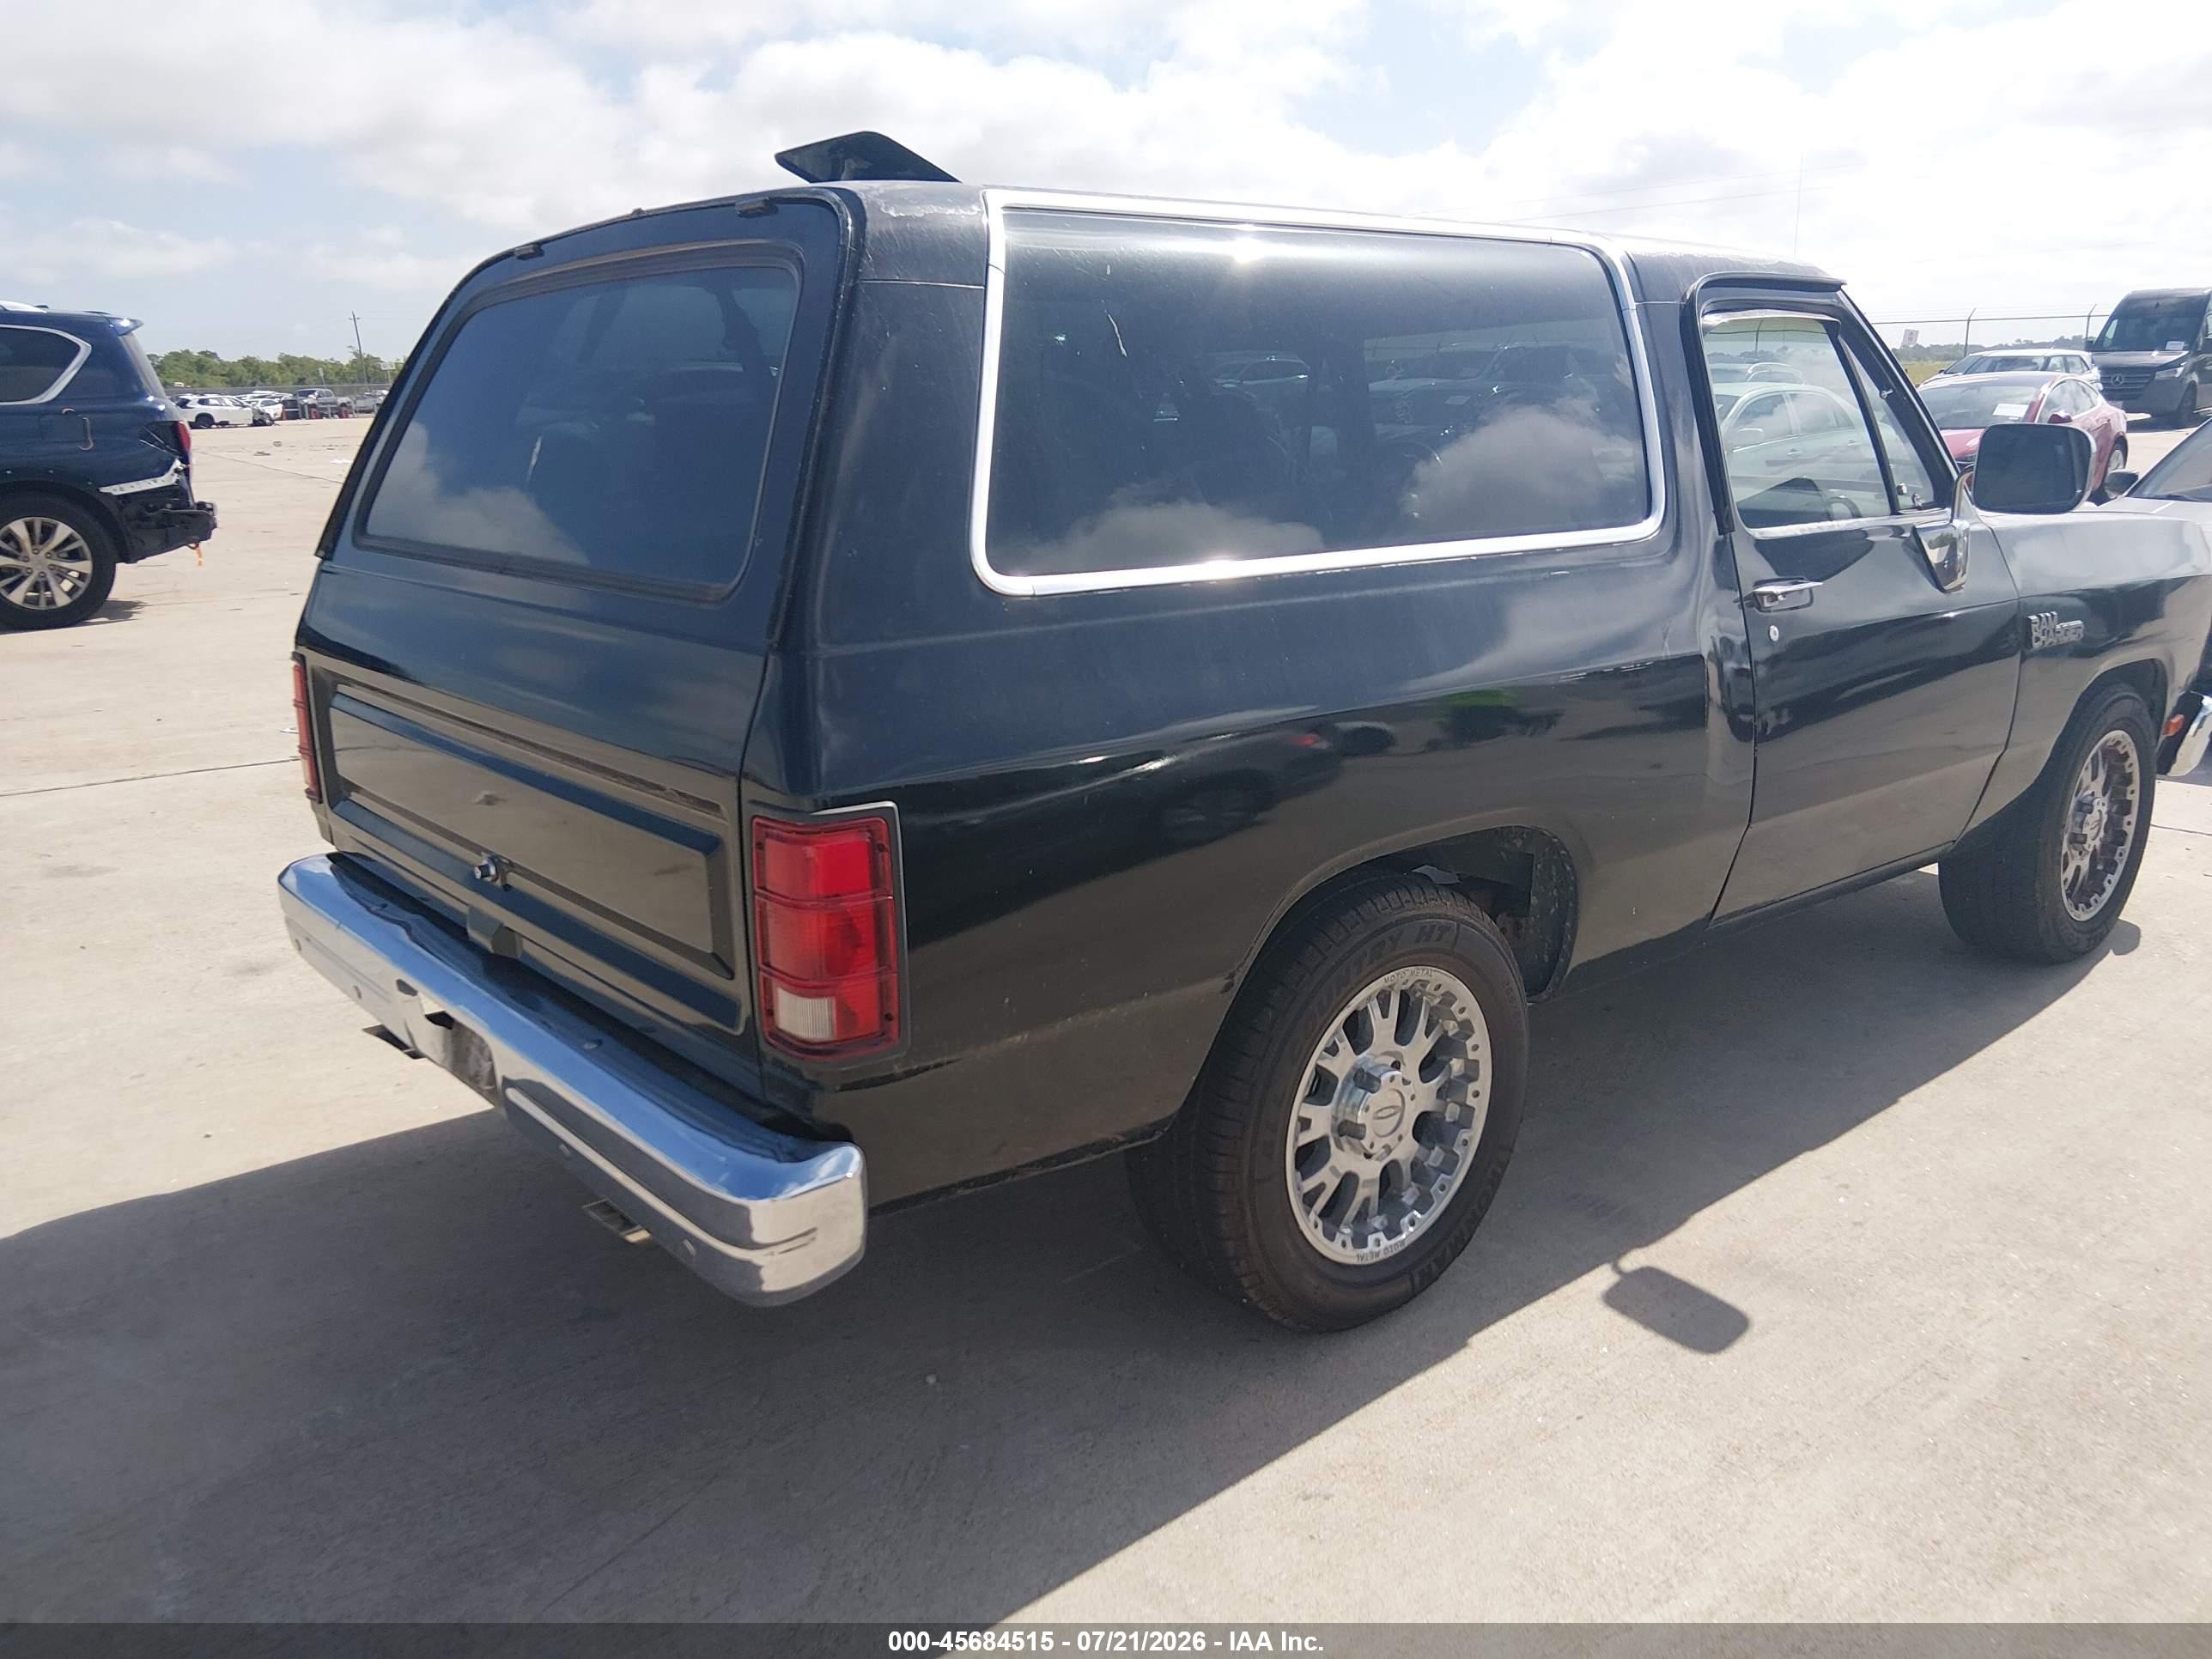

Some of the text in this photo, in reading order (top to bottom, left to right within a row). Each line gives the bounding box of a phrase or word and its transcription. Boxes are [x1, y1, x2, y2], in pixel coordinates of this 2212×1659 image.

[2027, 611, 2058, 633] RAM
[1415, 924, 1451, 945] HT
[1383, 968, 1433, 983] MOTO METAL
[1356, 1241, 1406, 1262] MOTO METAL
